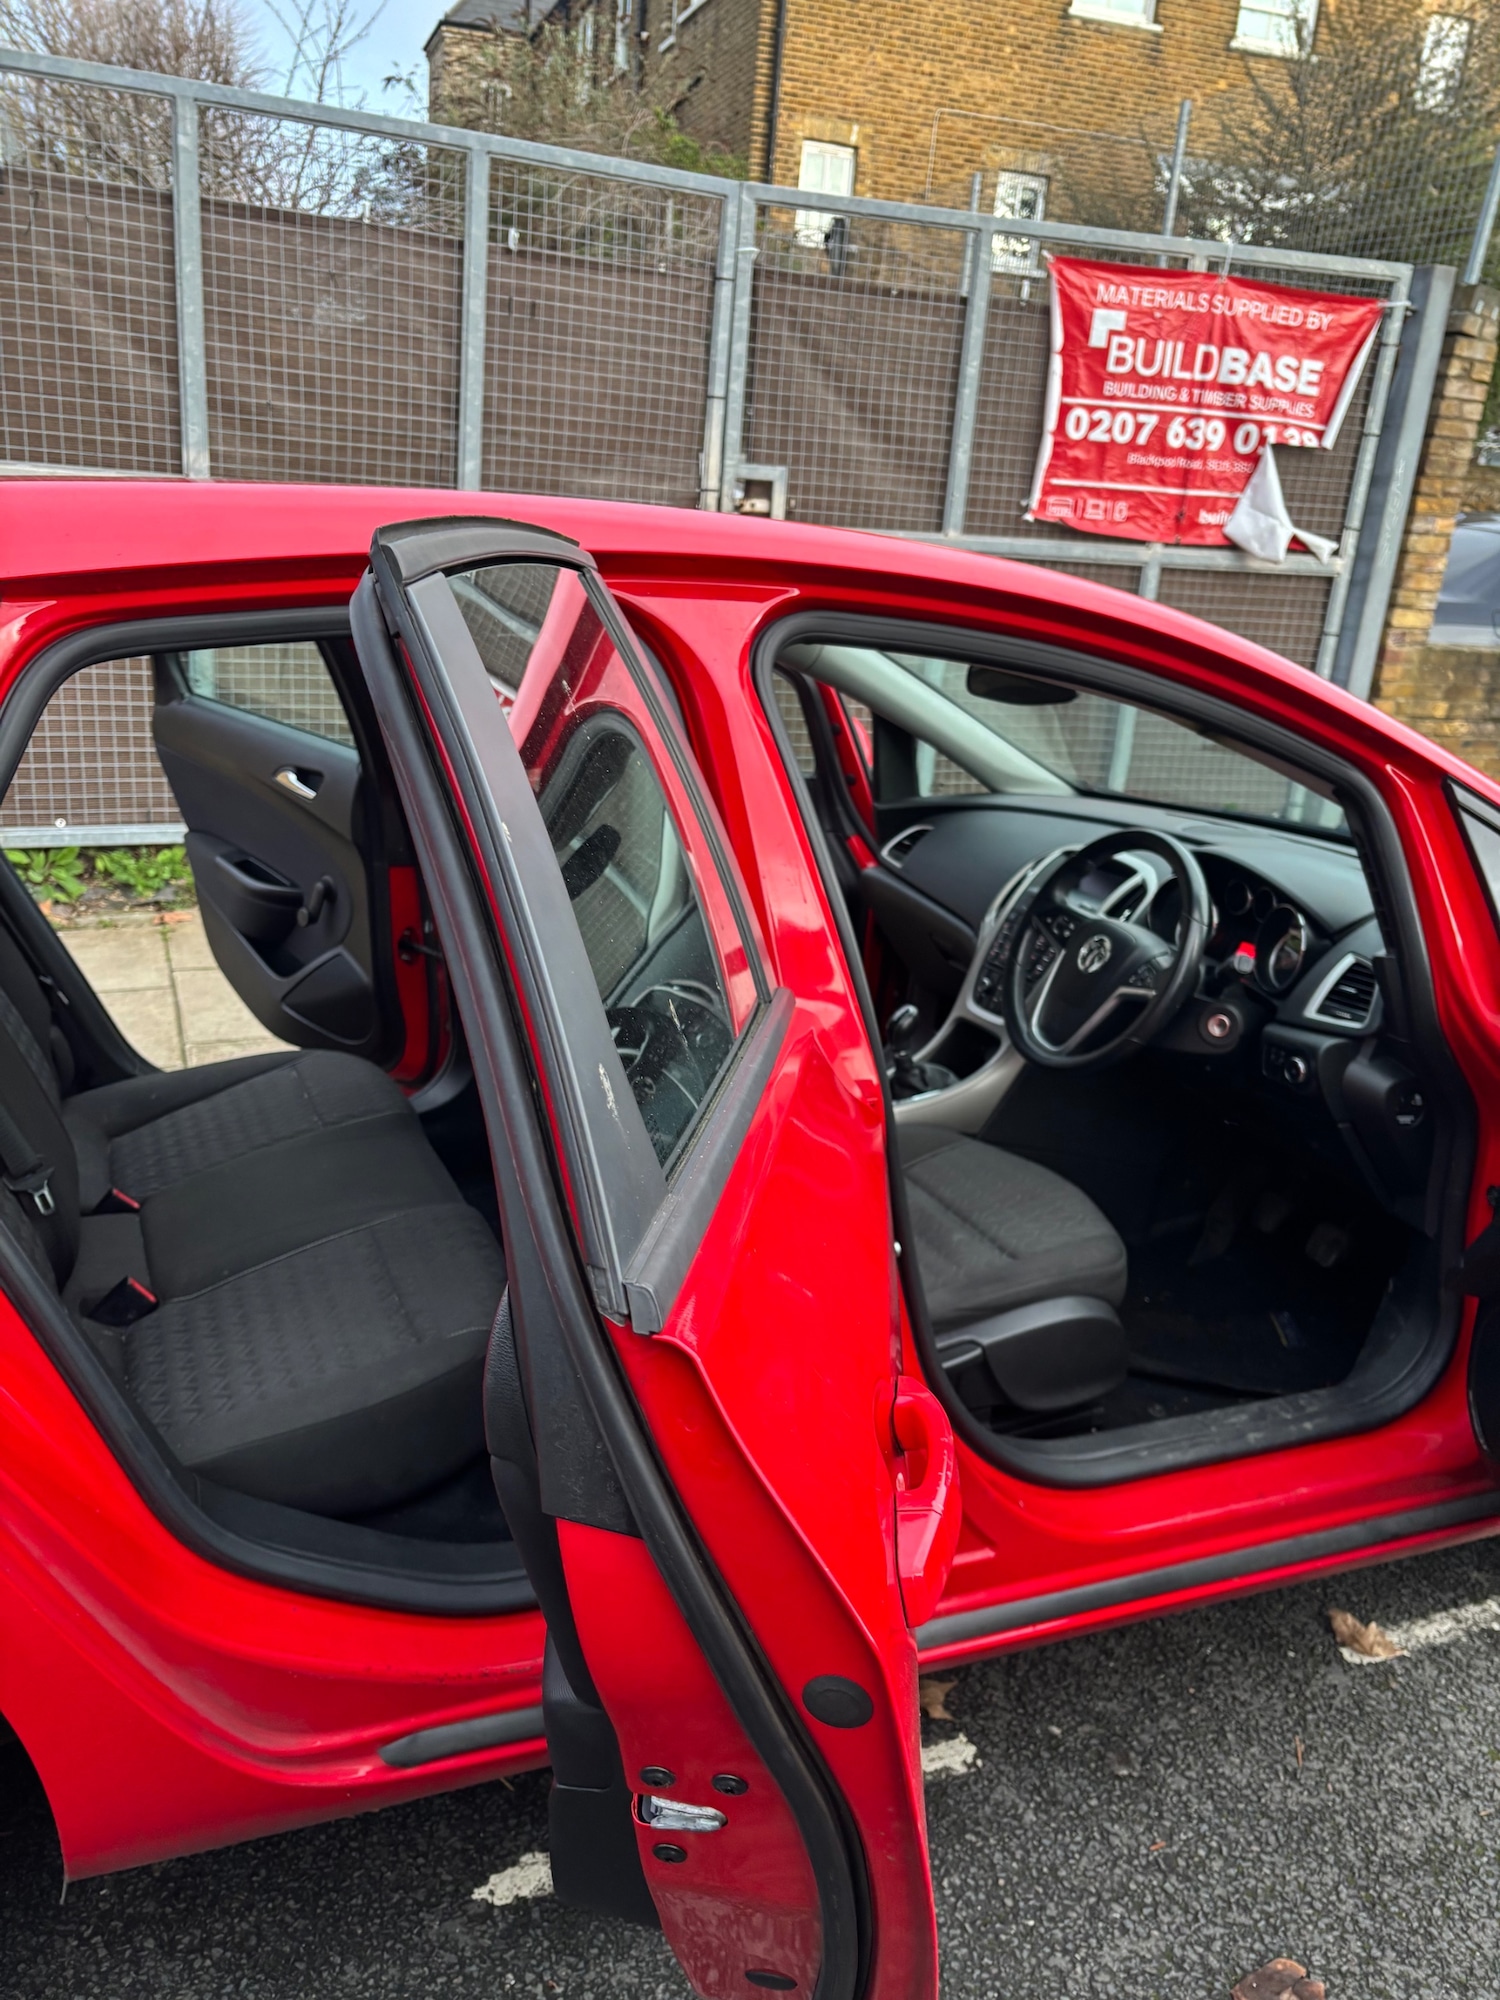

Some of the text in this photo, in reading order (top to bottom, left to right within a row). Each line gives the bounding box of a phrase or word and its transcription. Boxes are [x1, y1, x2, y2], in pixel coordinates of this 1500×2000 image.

[1096, 283, 1335, 331] MATERIALS SUPPLIED BY
[1106, 335, 1325, 397] BUILDBASE
[1103, 380, 1316, 419] BUILDING & TIMBER SUPPLIES
[1065, 409, 1160, 446] 0207
[1166, 415, 1227, 452] 639
